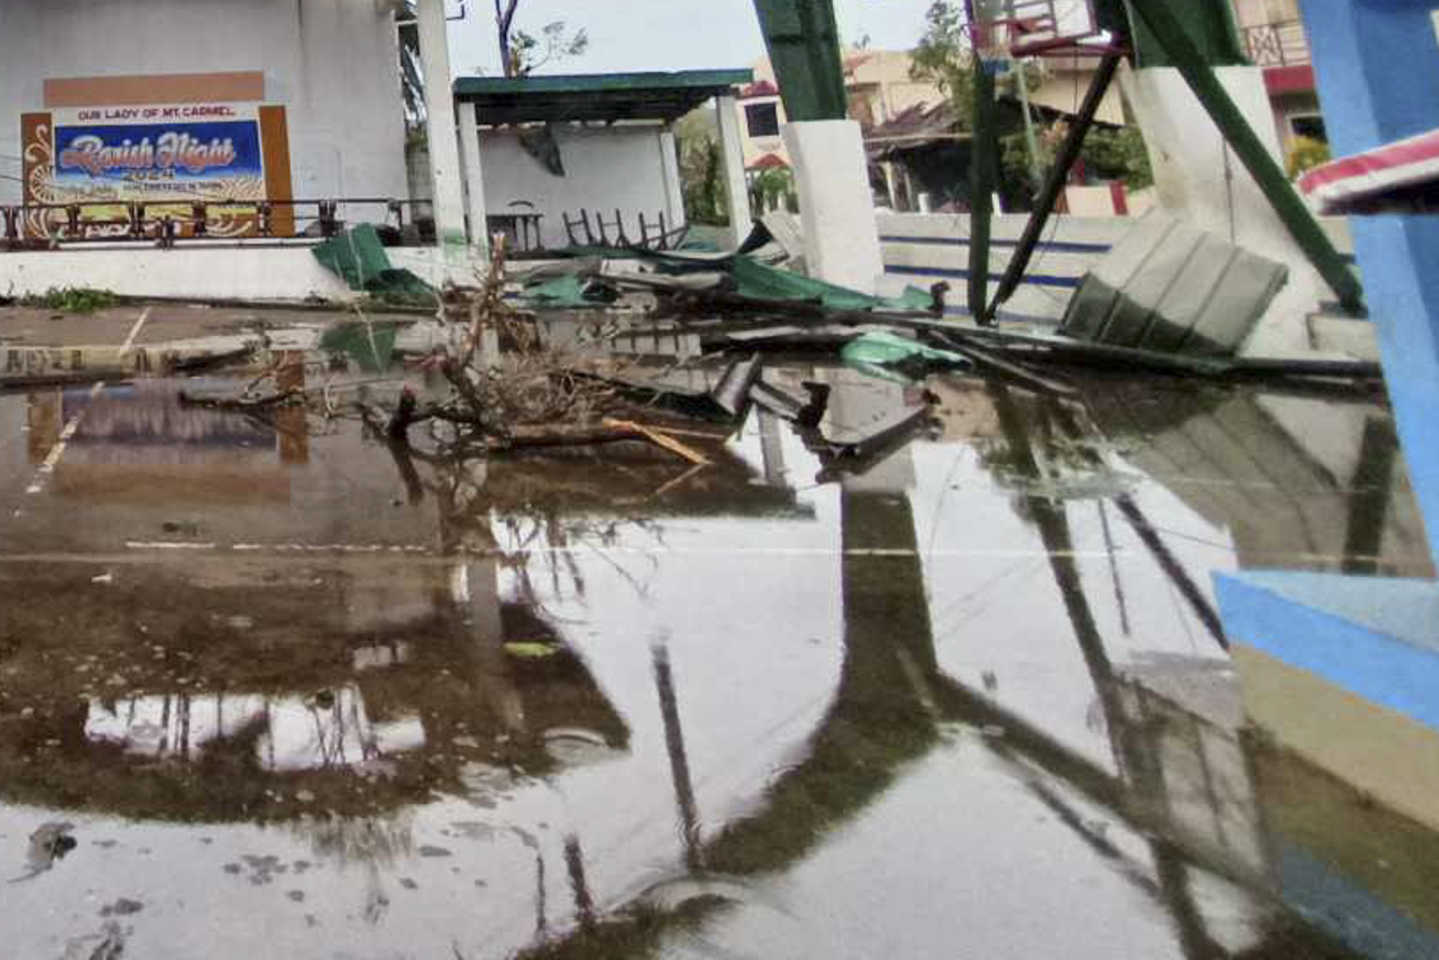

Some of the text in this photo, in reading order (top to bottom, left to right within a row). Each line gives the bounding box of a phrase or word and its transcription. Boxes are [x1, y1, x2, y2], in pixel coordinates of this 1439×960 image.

[78, 110, 101, 120] OUR
[105, 108, 139, 119] LADY
[143, 107, 160, 118] OF
[183, 105, 236, 116] CARMEL
[61, 131, 236, 175] Parish Night
